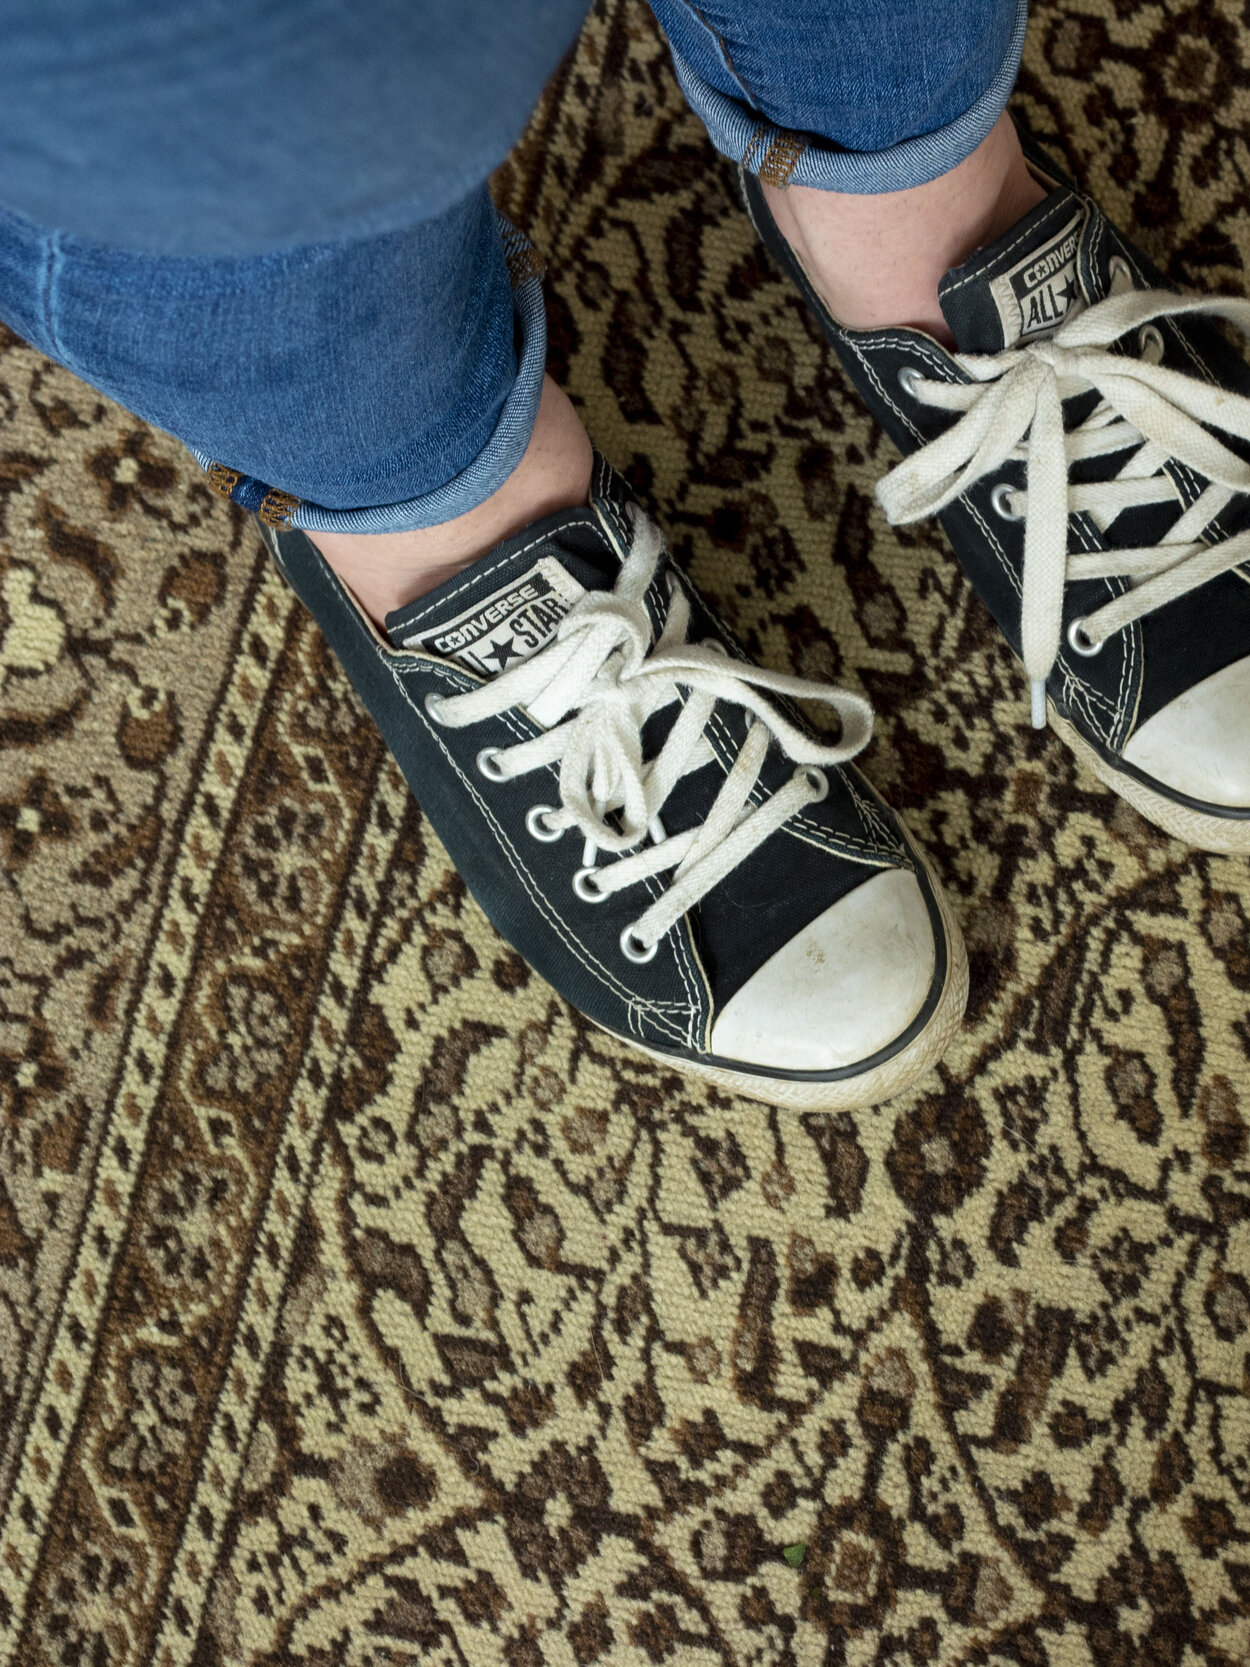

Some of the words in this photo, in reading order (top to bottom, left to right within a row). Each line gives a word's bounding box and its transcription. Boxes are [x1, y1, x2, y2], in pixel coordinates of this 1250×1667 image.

[1023, 230, 1080, 288] CONVER
[1026, 283, 1064, 329] ALL
[434, 584, 539, 653] CONVERSE
[509, 597, 569, 648] STAR
